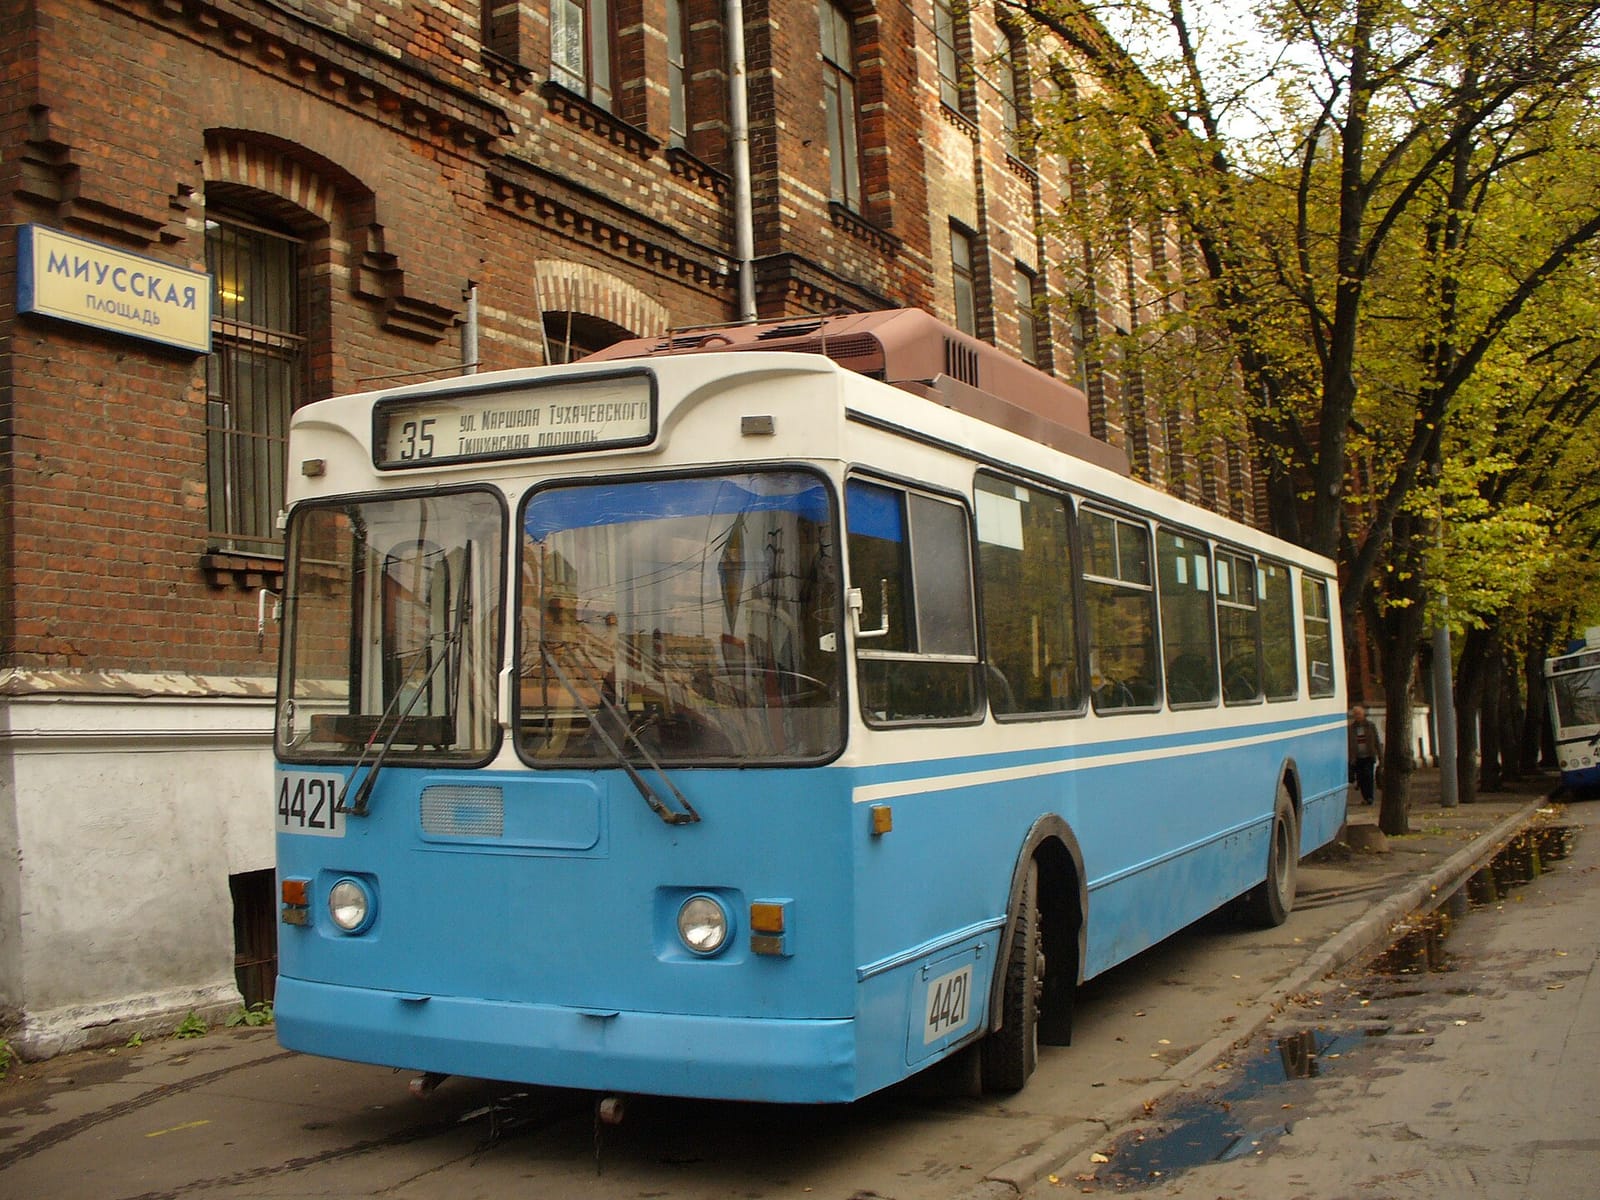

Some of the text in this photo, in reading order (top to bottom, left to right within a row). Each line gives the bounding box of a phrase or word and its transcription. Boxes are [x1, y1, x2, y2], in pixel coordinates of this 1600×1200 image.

[47, 250, 196, 310] МИУССКАЯ
[86, 294, 160, 326] ПЛОЩАДЬ
[401, 419, 437, 460] 35
[278, 777, 335, 829] 4421
[929, 972, 968, 1032] 4421
